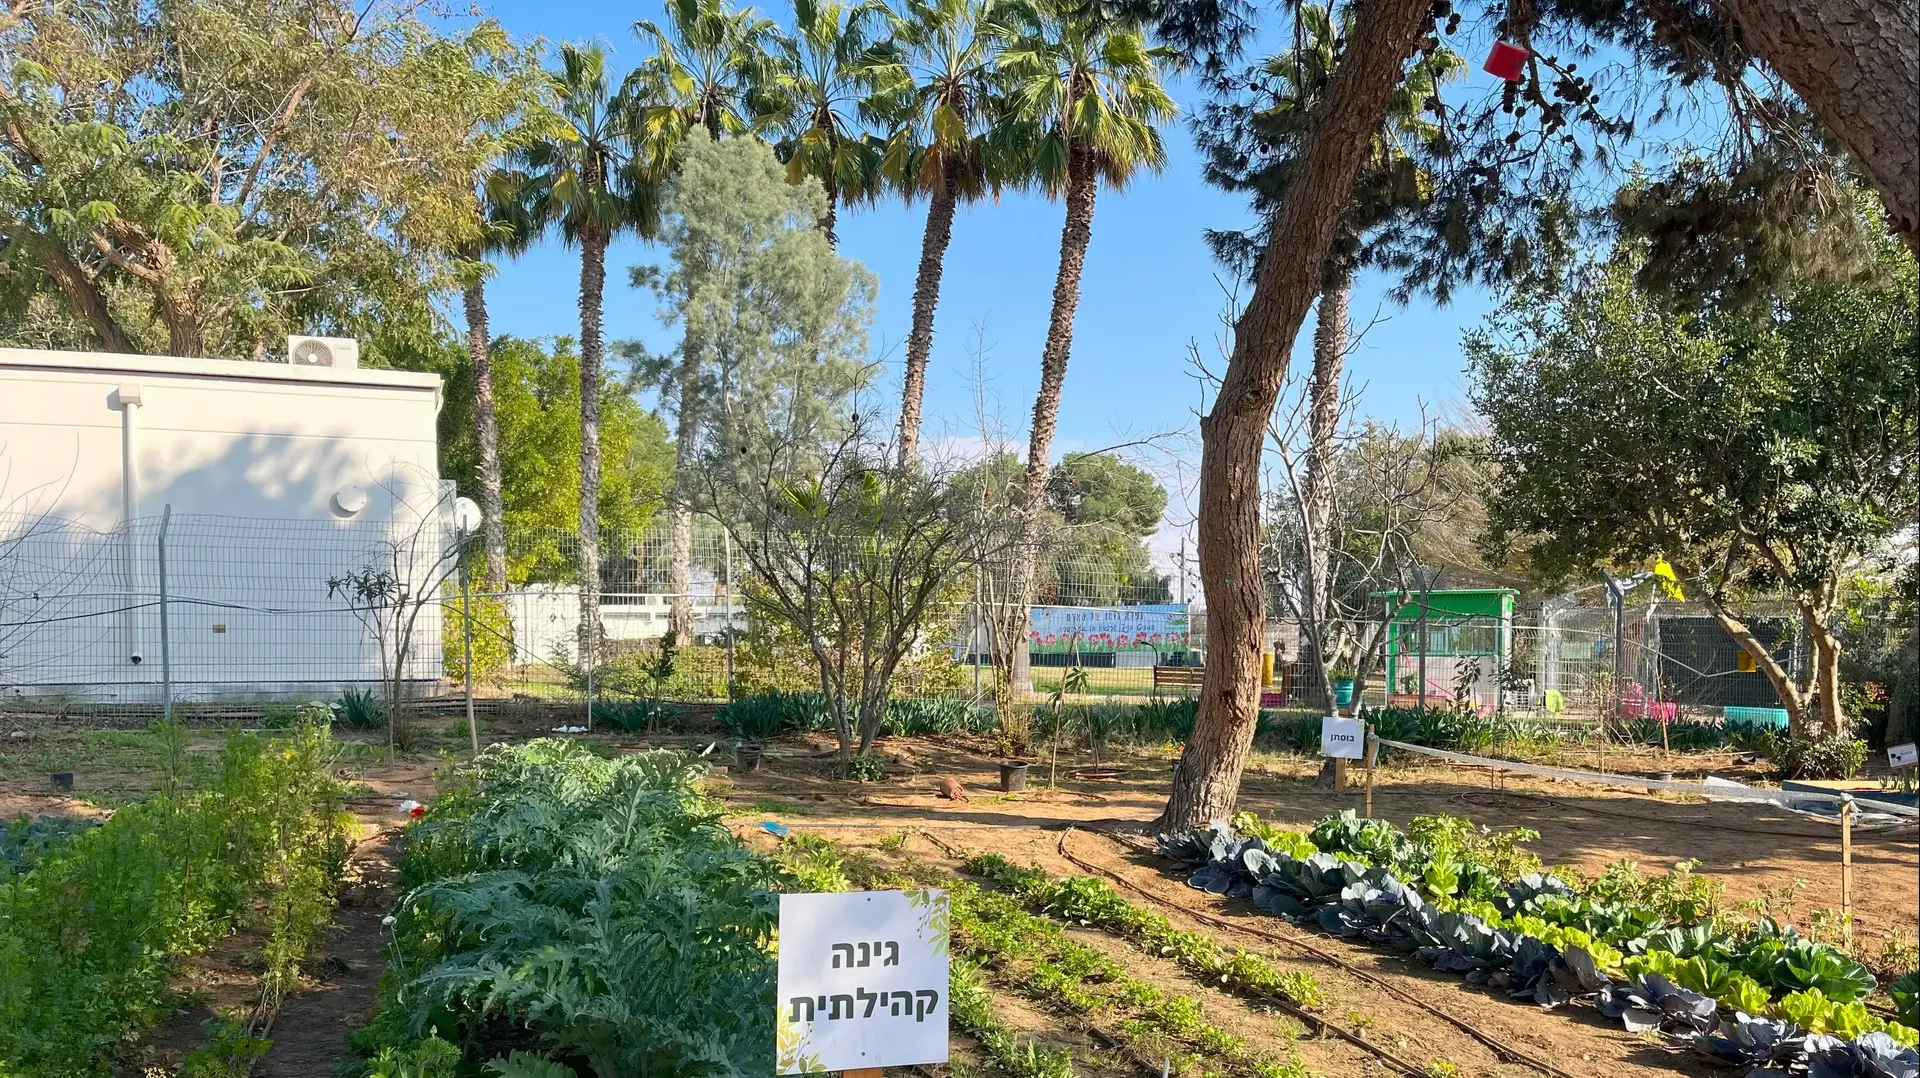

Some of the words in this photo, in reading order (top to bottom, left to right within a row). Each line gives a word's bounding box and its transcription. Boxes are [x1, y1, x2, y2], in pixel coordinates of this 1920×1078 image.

[1330, 734, 1355, 742] בוסתן
[831, 940, 899, 969] גינה
[788, 987, 939, 1023] קהילתית
